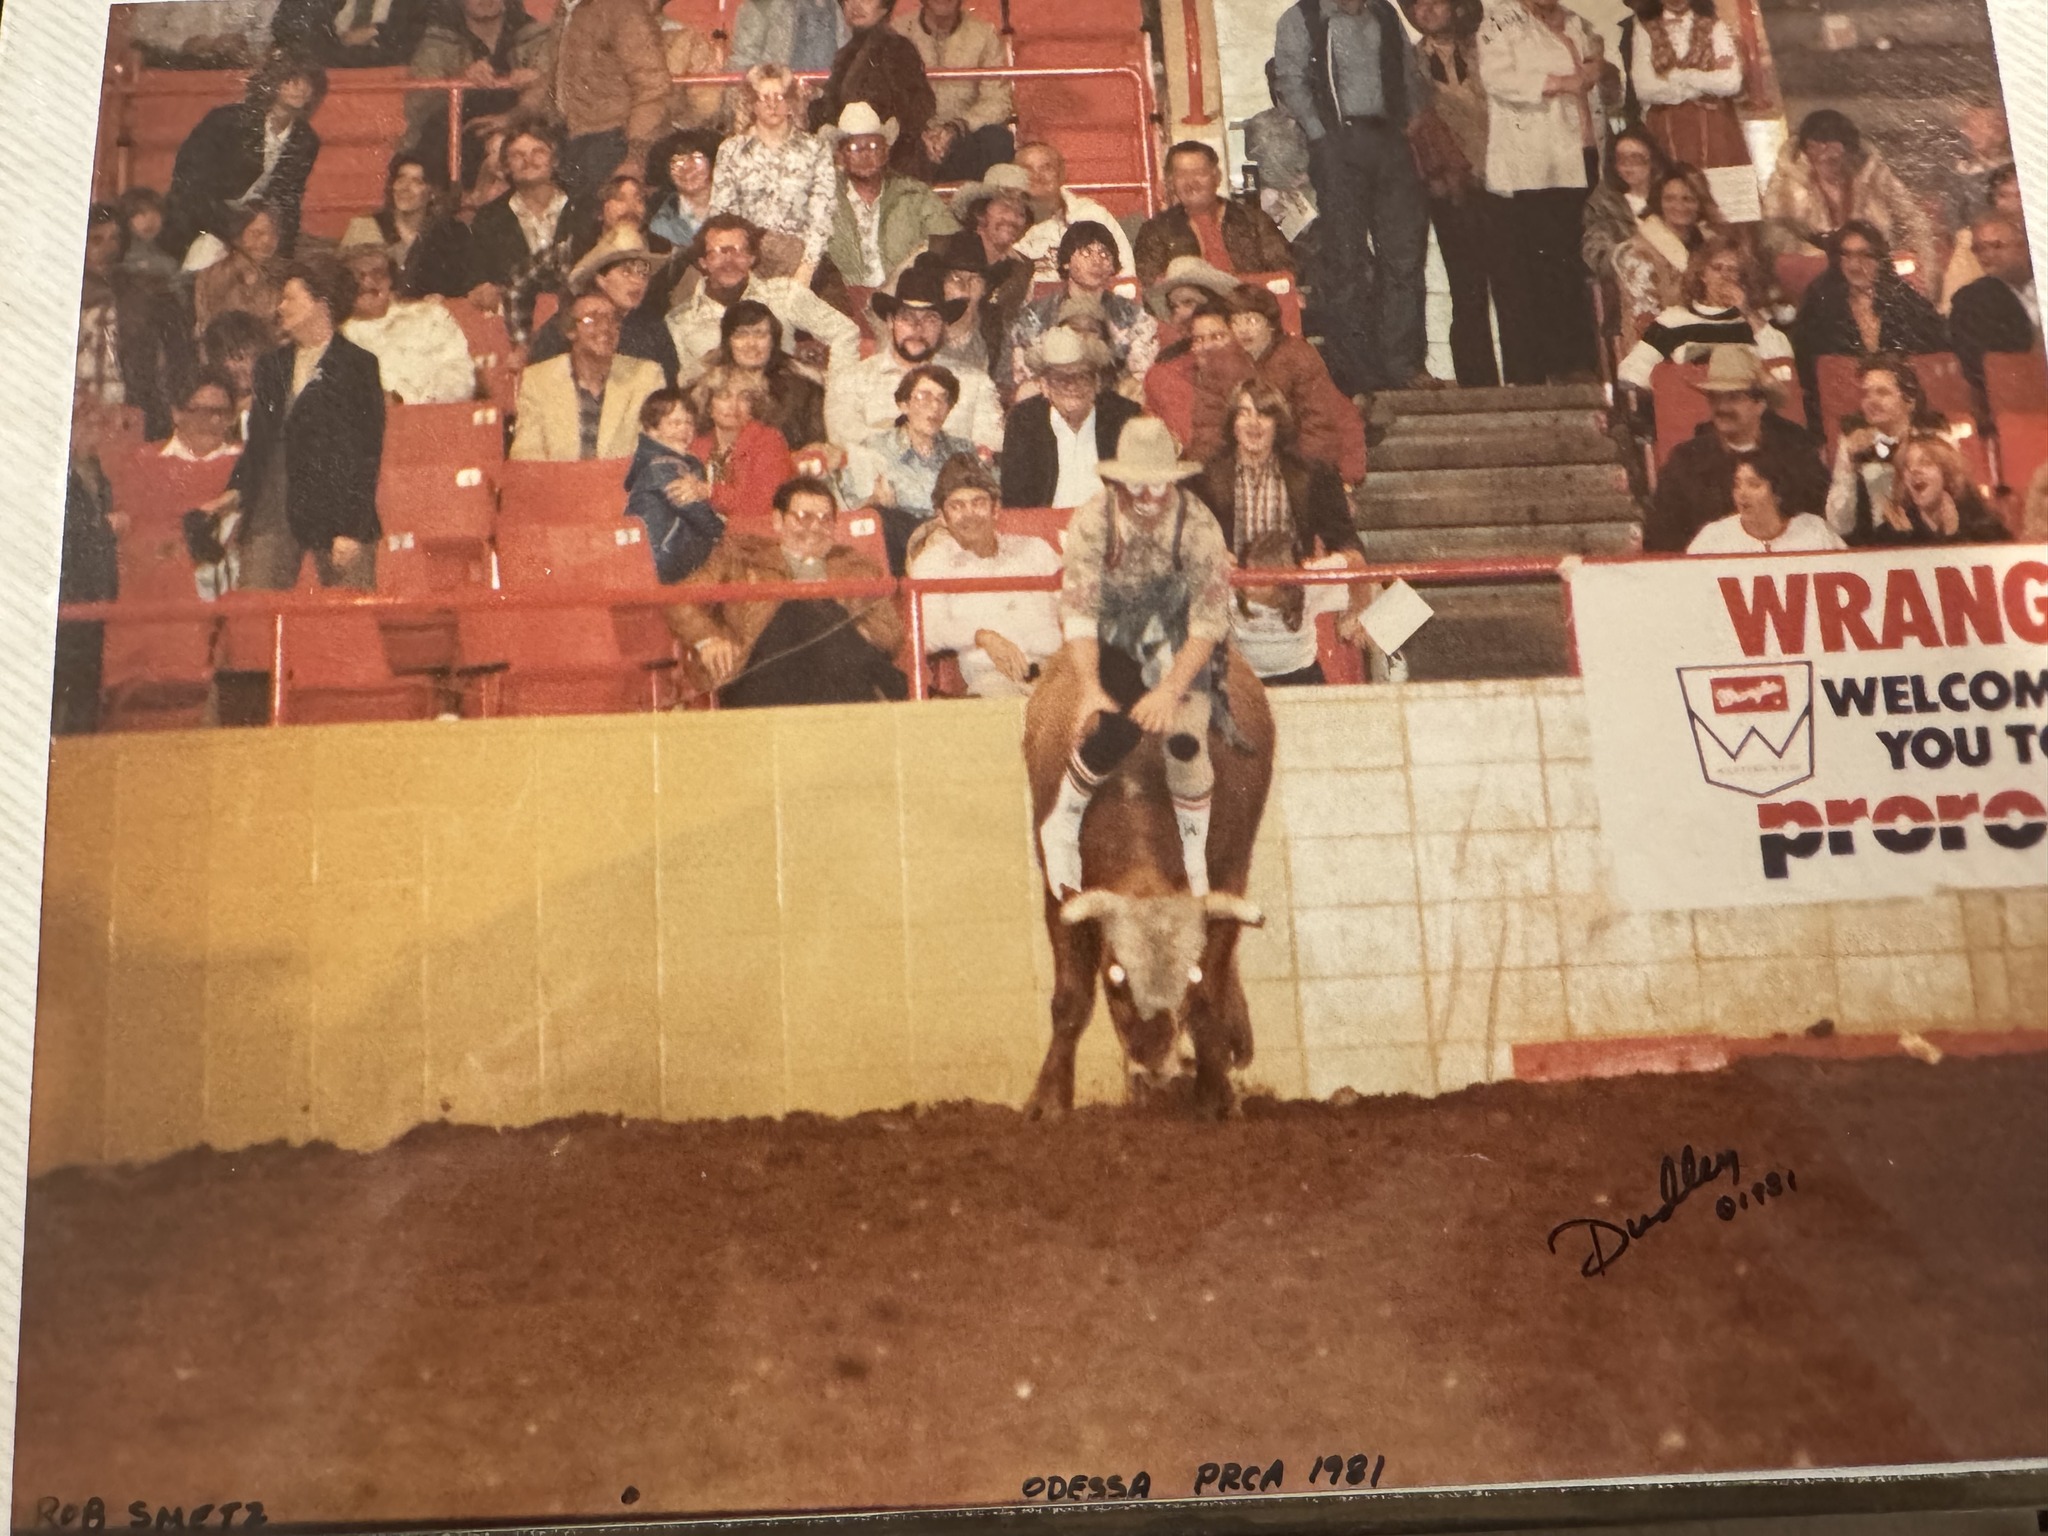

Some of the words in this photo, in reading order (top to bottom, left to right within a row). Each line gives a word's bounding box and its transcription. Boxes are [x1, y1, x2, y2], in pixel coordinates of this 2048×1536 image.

[1717, 561, 2048, 657] WRANG
[1875, 726, 1992, 770] YOU
[2005, 724, 2048, 764] T
[1021, 1471, 1151, 1500] ODESSA
[1194, 1458, 1284, 1494] PRCA
[1309, 1453, 1384, 1487] 1981
